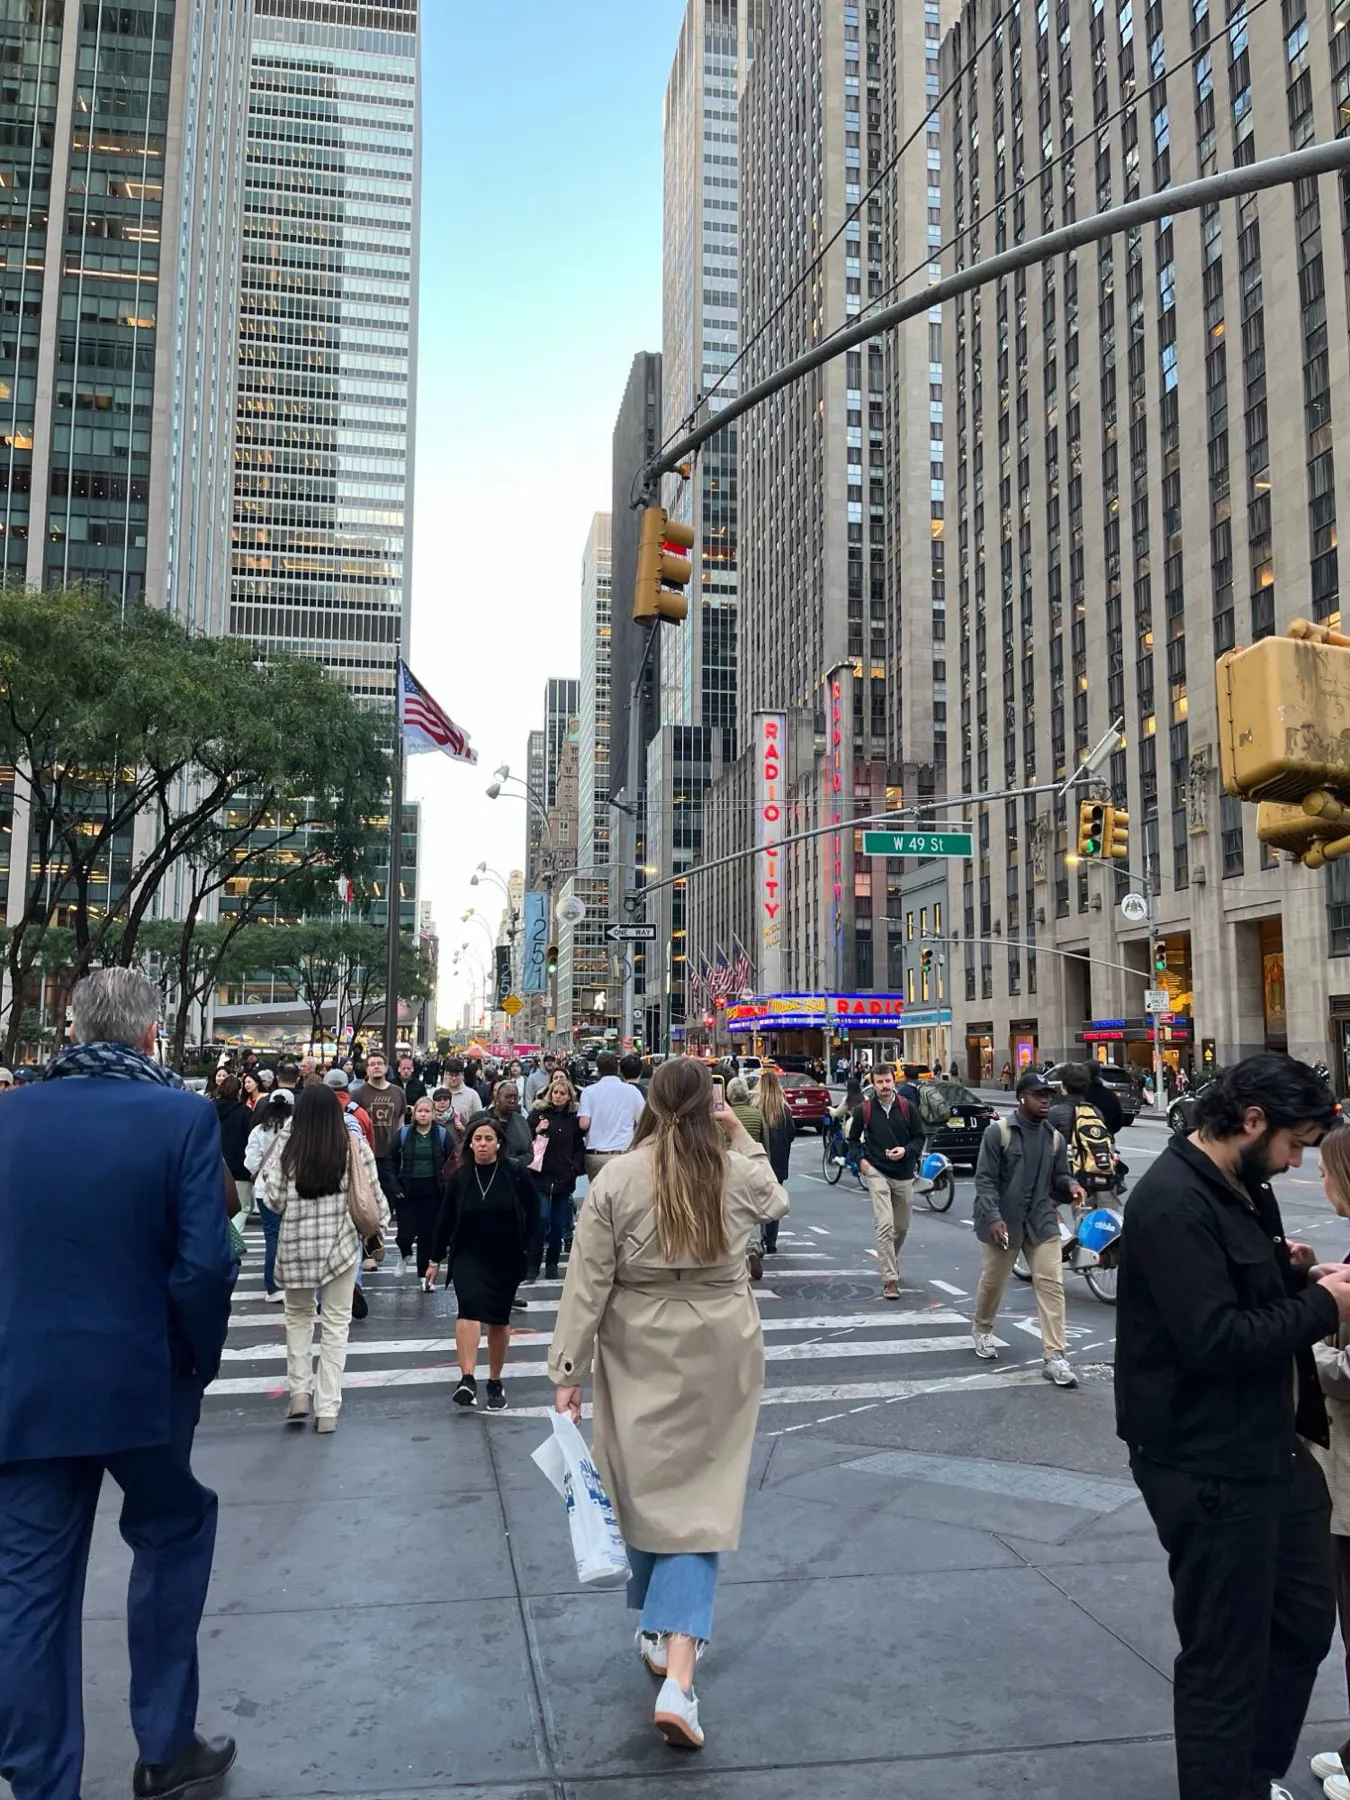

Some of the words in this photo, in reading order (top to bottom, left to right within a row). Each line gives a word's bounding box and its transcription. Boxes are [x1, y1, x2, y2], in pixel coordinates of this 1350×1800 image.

[764, 722, 780, 822] RADIO
[893, 837, 904, 851] W
[908, 837, 925, 851] 49
[930, 837, 944, 852] St
[500, 948, 511, 999] 125
[531, 895, 547, 989] 1251
